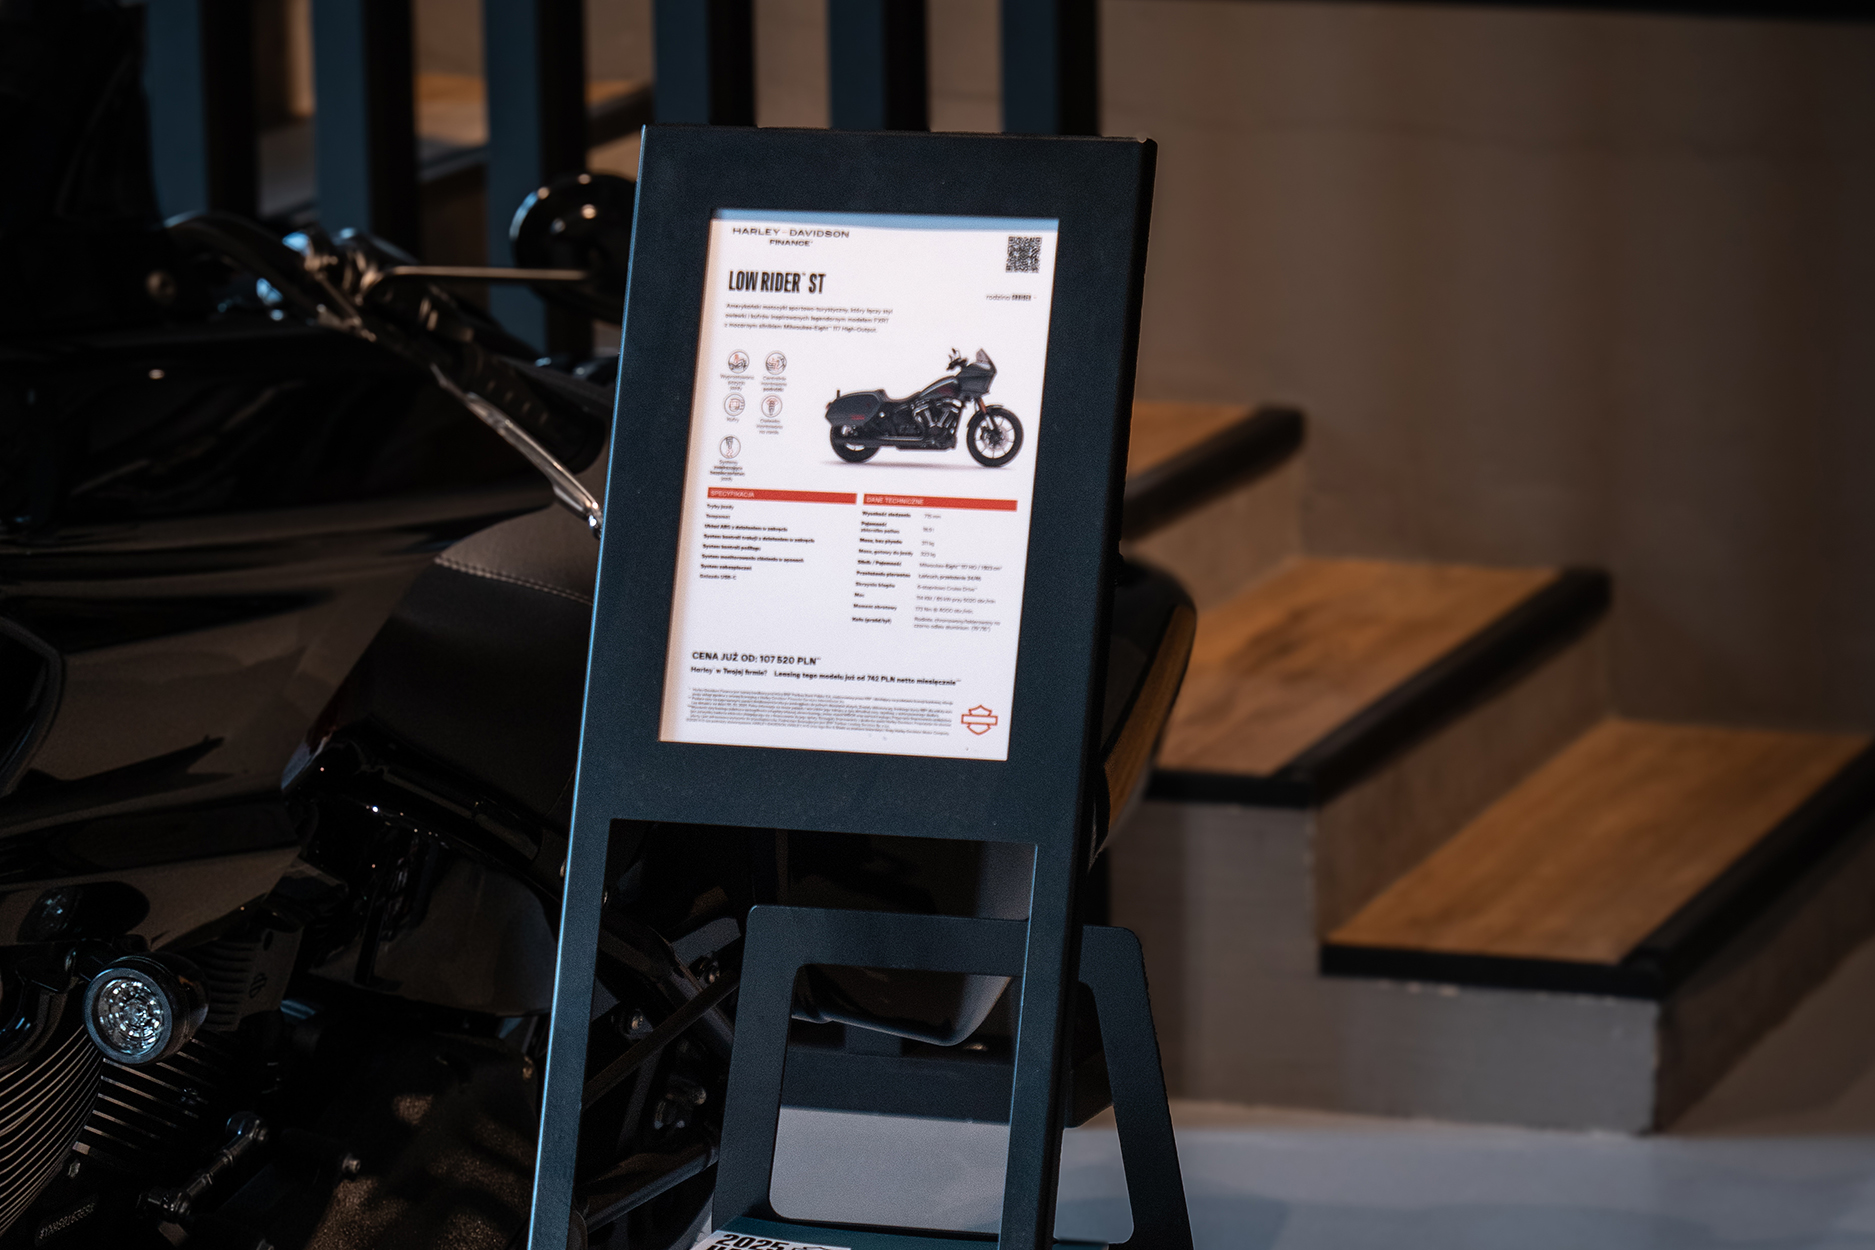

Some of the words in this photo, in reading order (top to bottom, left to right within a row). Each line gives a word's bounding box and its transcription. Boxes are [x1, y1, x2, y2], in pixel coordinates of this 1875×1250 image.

[728, 270, 758, 292] LOW
[808, 273, 826, 294] ST
[710, 490, 755, 498] SPECYFIKACJA
[885, 497, 924, 505] TECHNICZNE
[692, 651, 719, 661] CENA
[720, 652, 739, 662] JUŻ
[740, 654, 758, 663] OD:
[760, 655, 776, 664] 107
[776, 655, 795, 665] 520
[723, 668, 744, 677] Twojej
[745, 669, 768, 677] firmie?
[774, 670, 801, 680] Leasing
[802, 672, 818, 681] tego
[844, 674, 855, 682] już
[880, 675, 896, 683] PLN
